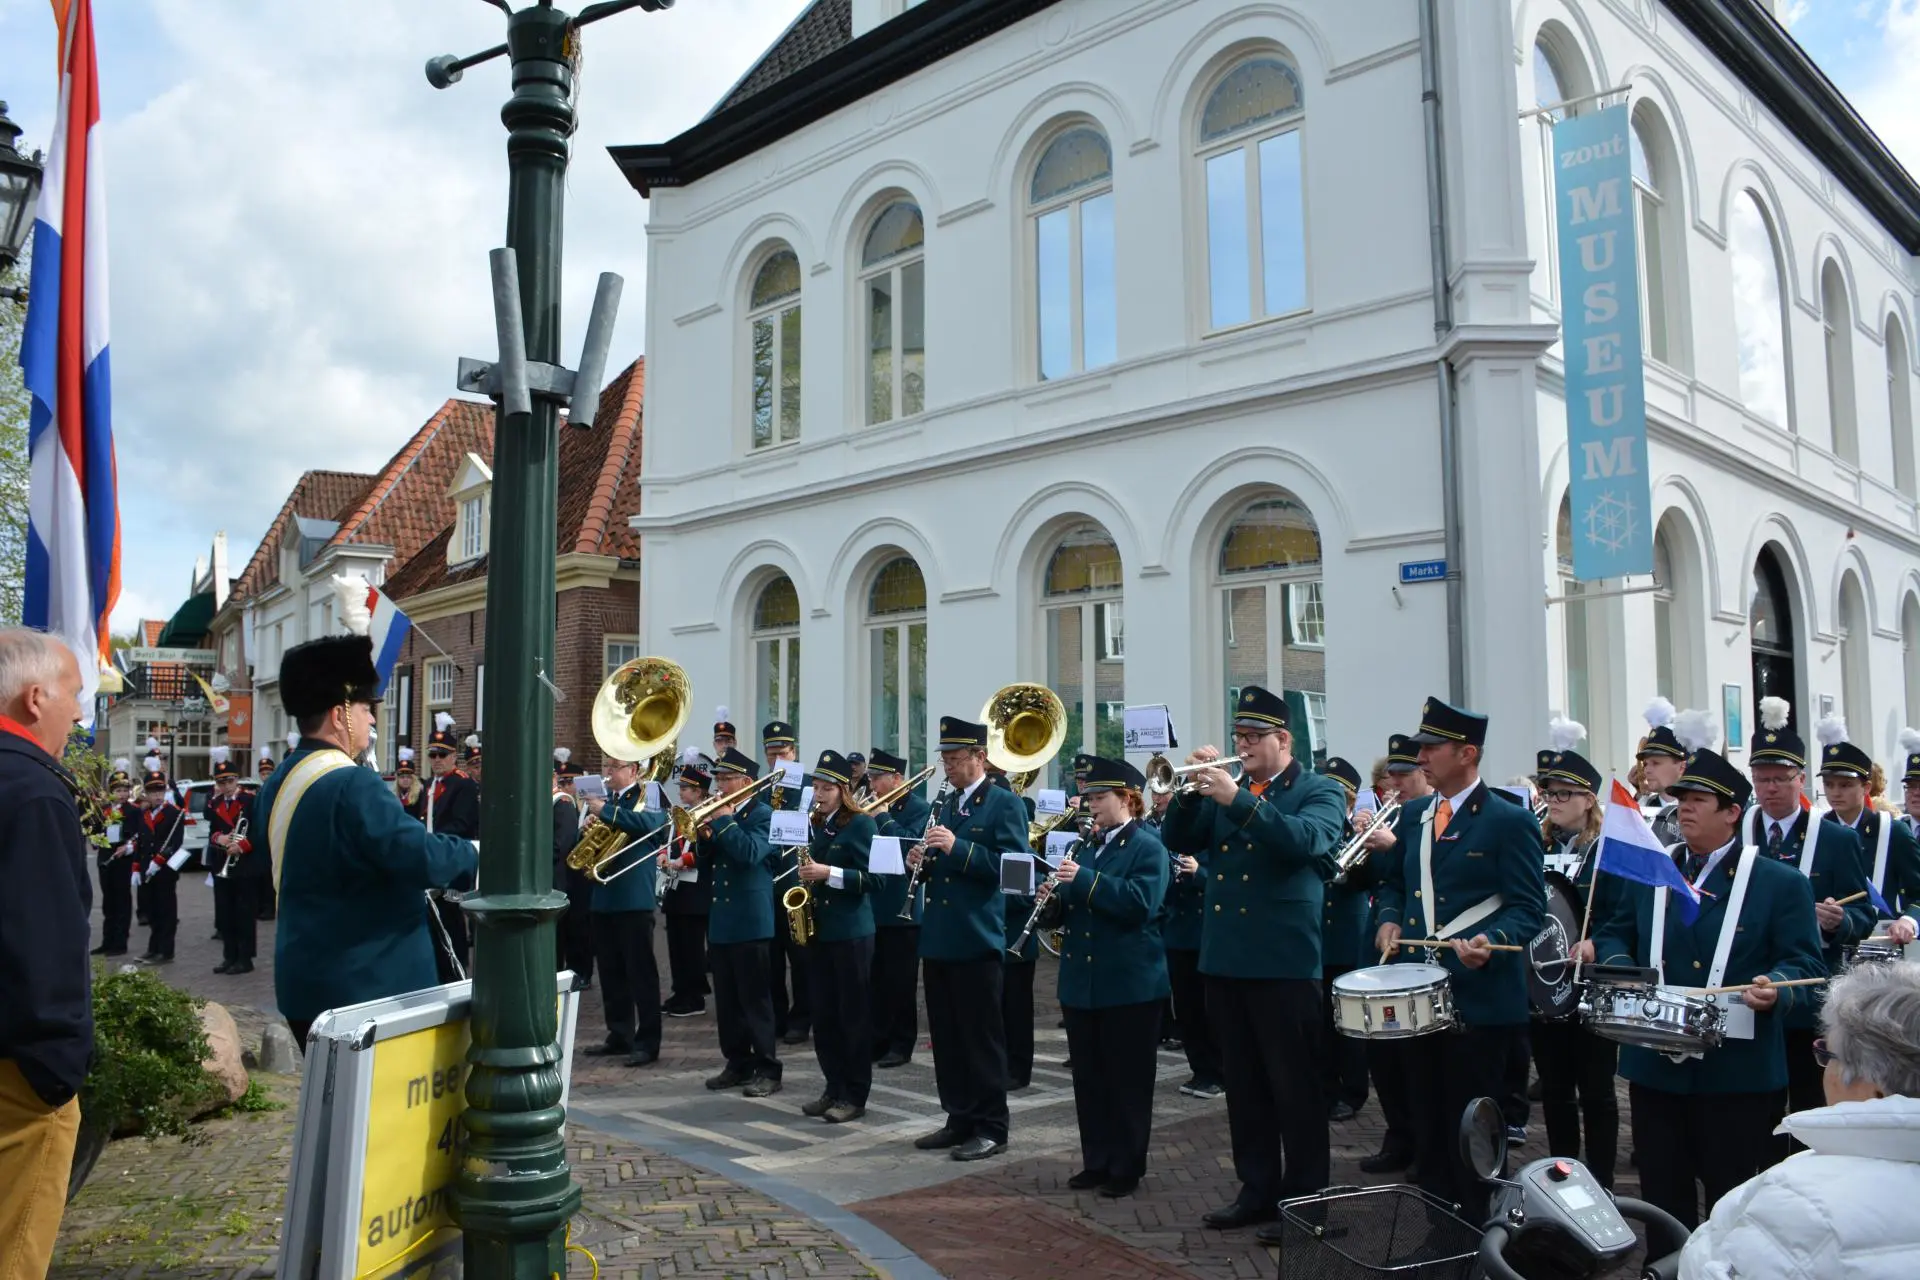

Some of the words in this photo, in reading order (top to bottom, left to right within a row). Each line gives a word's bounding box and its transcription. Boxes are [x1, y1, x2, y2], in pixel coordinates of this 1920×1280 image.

[1561, 134, 1624, 168] zout
[1569, 177, 1637, 480] MUSEUM
[1409, 566, 1439, 577] Markt
[1533, 924, 1558, 950] AMICITIA
